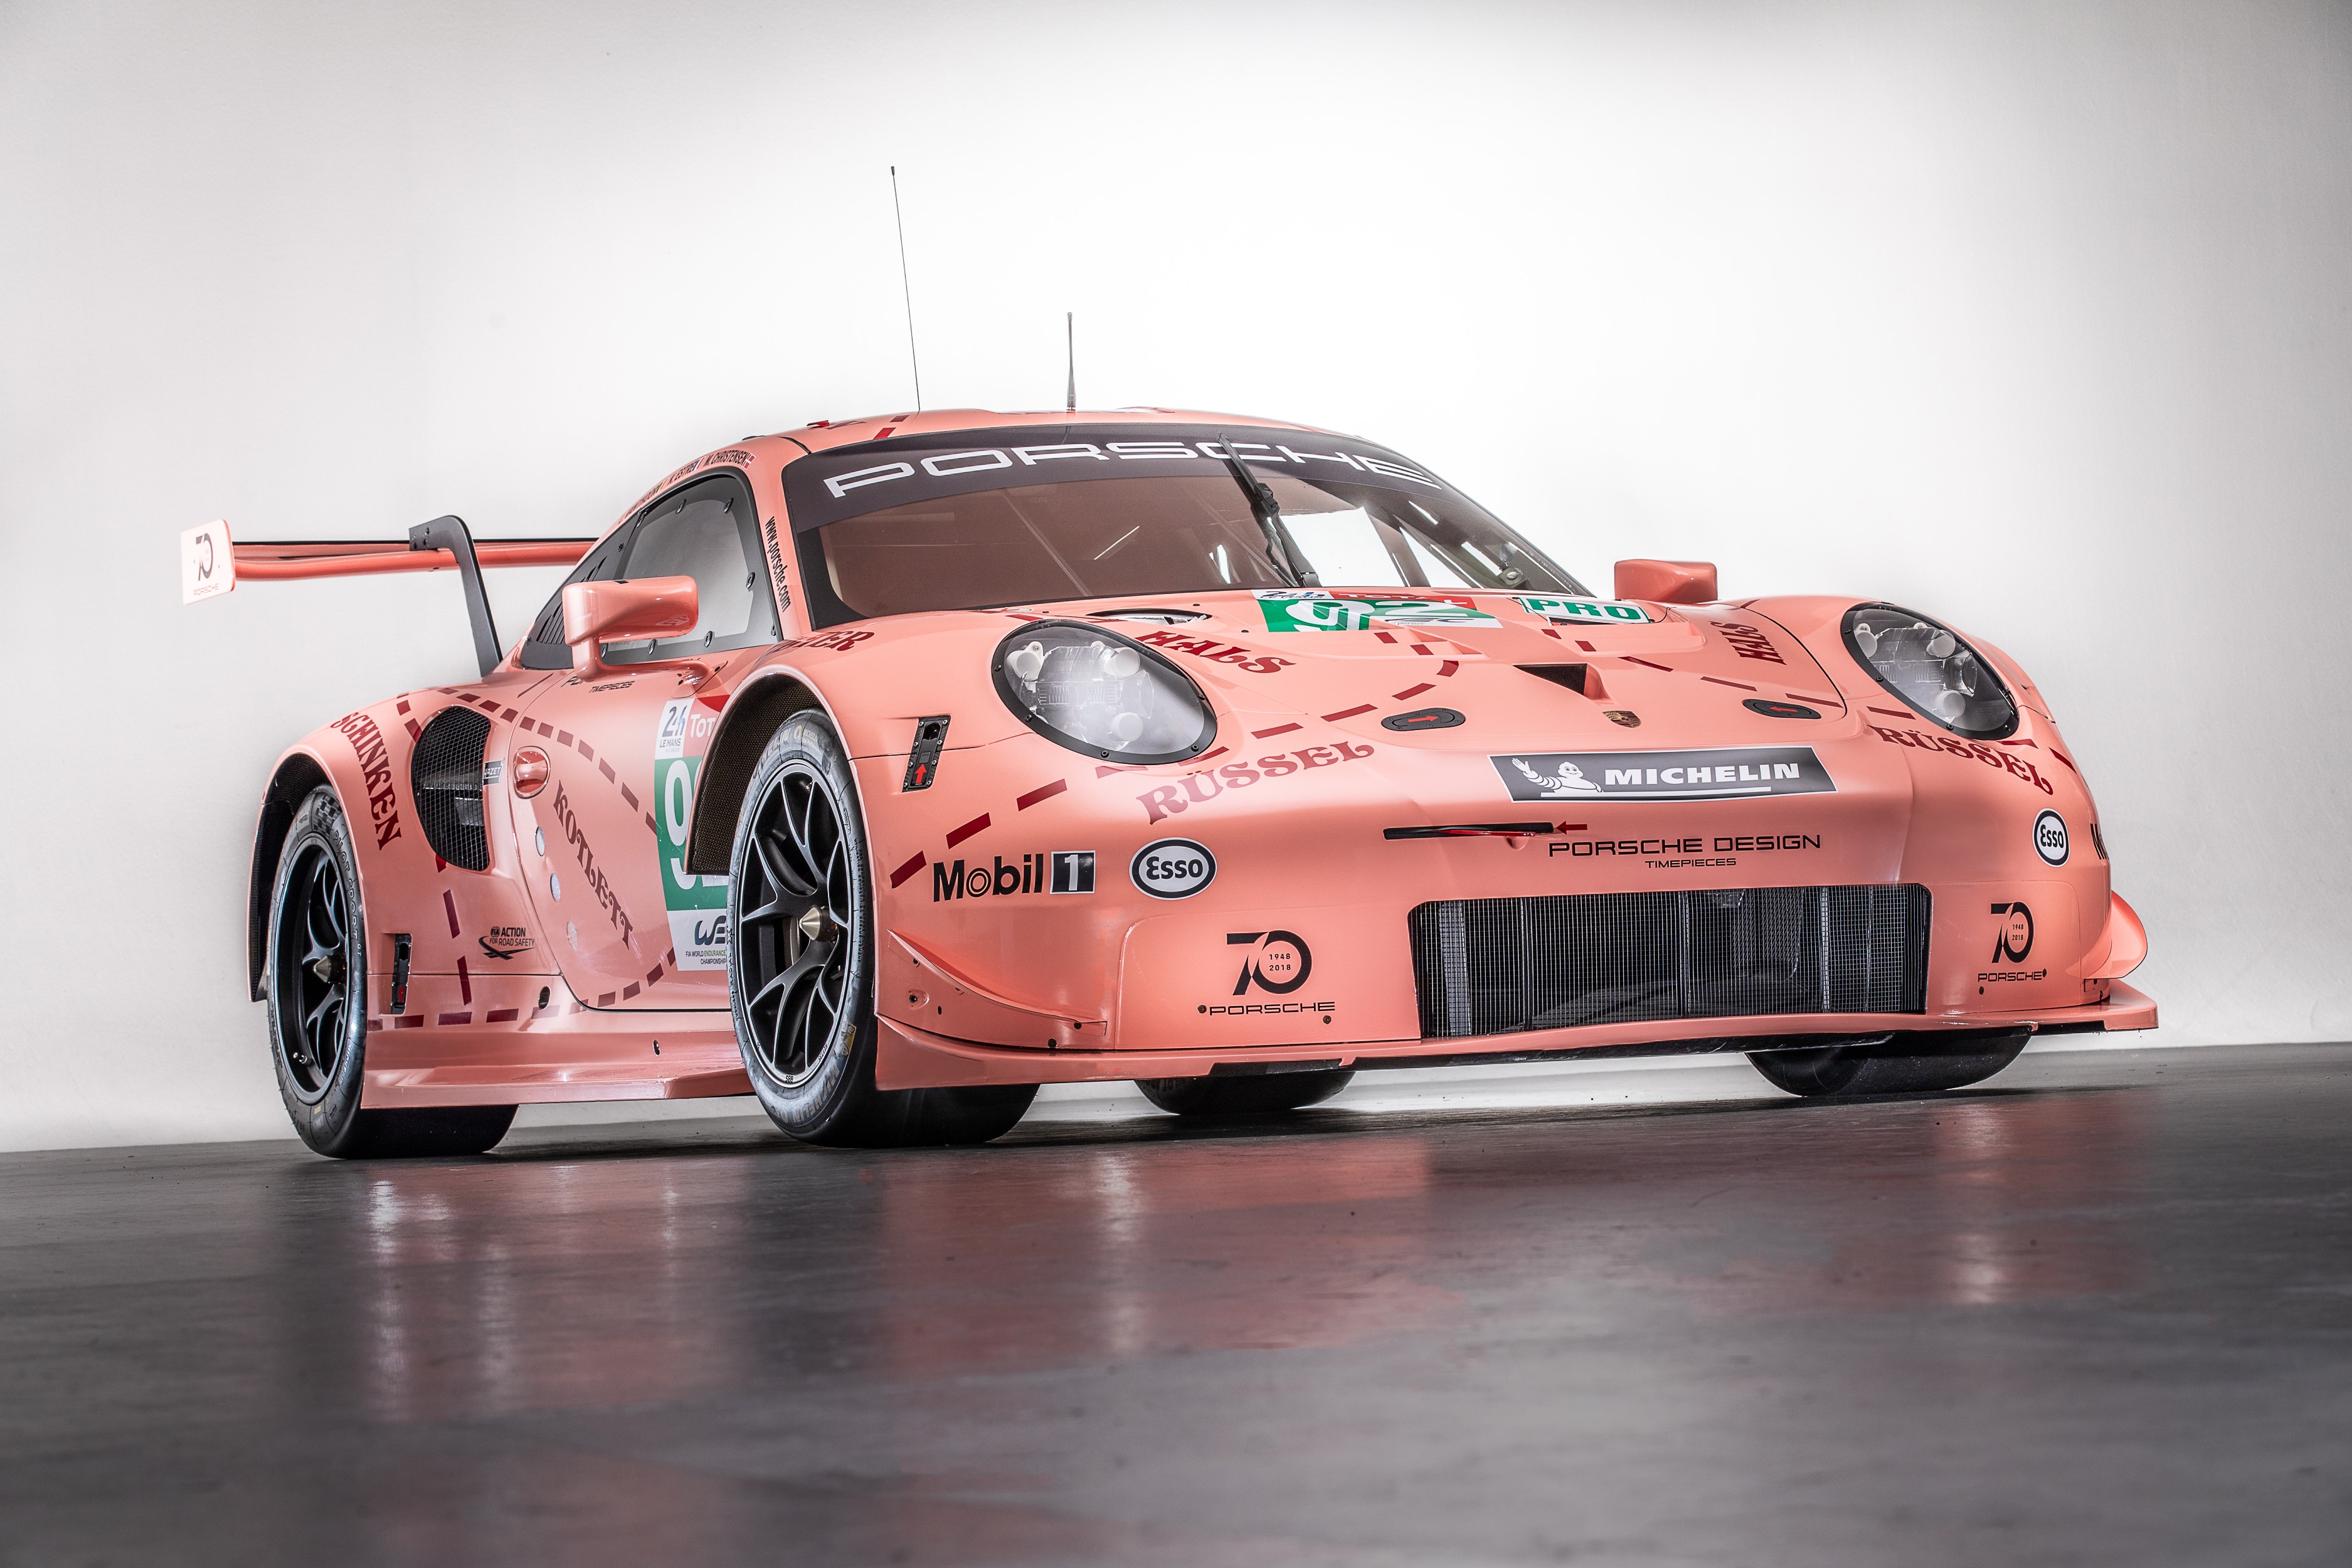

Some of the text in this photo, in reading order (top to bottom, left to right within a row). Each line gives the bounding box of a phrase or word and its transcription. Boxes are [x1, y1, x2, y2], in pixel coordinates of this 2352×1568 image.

[711, 450, 750, 465] CHRISTENSEN
[823, 441, 1442, 499] PORSCHE
[765, 516, 792, 613] www.porsche.com
[1526, 598, 1641, 620] PRO
[1133, 630, 1297, 674] HALS
[1708, 620, 1788, 665] HALS
[588, 681, 635, 693] TIMEPIECES
[659, 738, 681, 748] LE MANS
[689, 714, 716, 738] TOT
[1604, 763, 1801, 786] MICHELIN
[1867, 724, 2054, 795] RÜSSEL
[330, 711, 402, 850] SCHINKEN
[1136, 740, 1375, 826] RÜSSEL
[333, 829, 351, 872] PILOT
[1549, 834, 1821, 857] PORSCHE DESIGN
[2039, 825, 2065, 849] Esso
[553, 778, 633, 950] KOTLETT
[933, 853, 1044, 902] Mobil
[1145, 856, 1204, 881] Esso
[1645, 857, 1737, 869] TIMEPIECES
[346, 879, 359, 940] SPORT
[501, 927, 526, 937] ACTION
[1990, 901, 2034, 964] 70
[1226, 930, 1313, 995] 70
[1978, 970, 2043, 981] PORSCHE
[1209, 1001, 1336, 1015] PORSCHE
